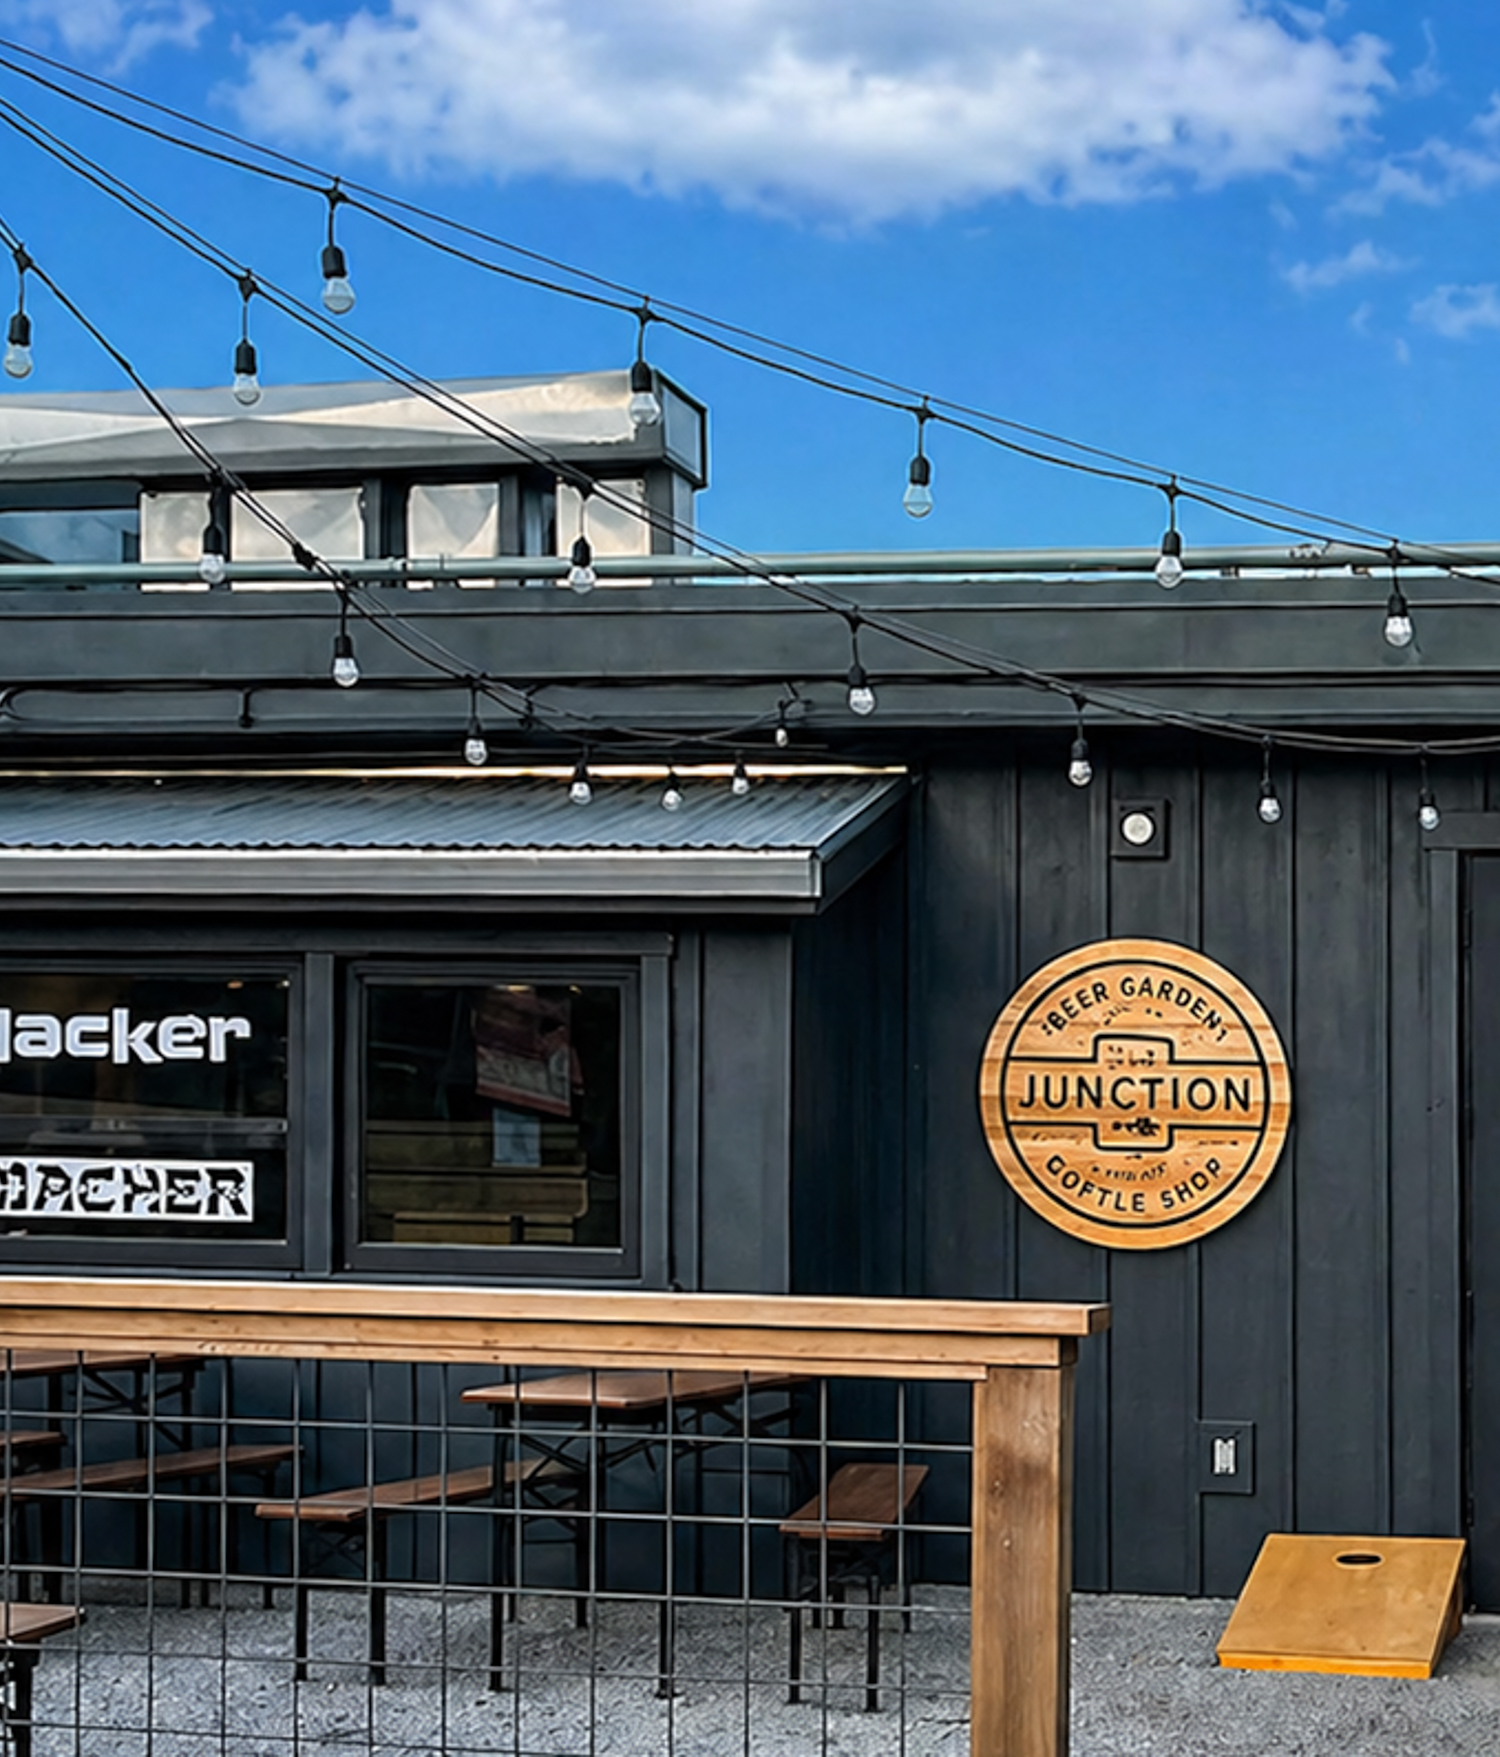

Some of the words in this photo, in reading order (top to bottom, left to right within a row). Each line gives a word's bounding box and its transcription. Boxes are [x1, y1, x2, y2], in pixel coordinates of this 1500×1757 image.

[1047, 982, 1109, 1031] BEER
[1120, 976, 1222, 1030] GARDEN
[1019, 1074, 1250, 1112] JUNCTION
[1160, 1157, 1221, 1210] SHOP
